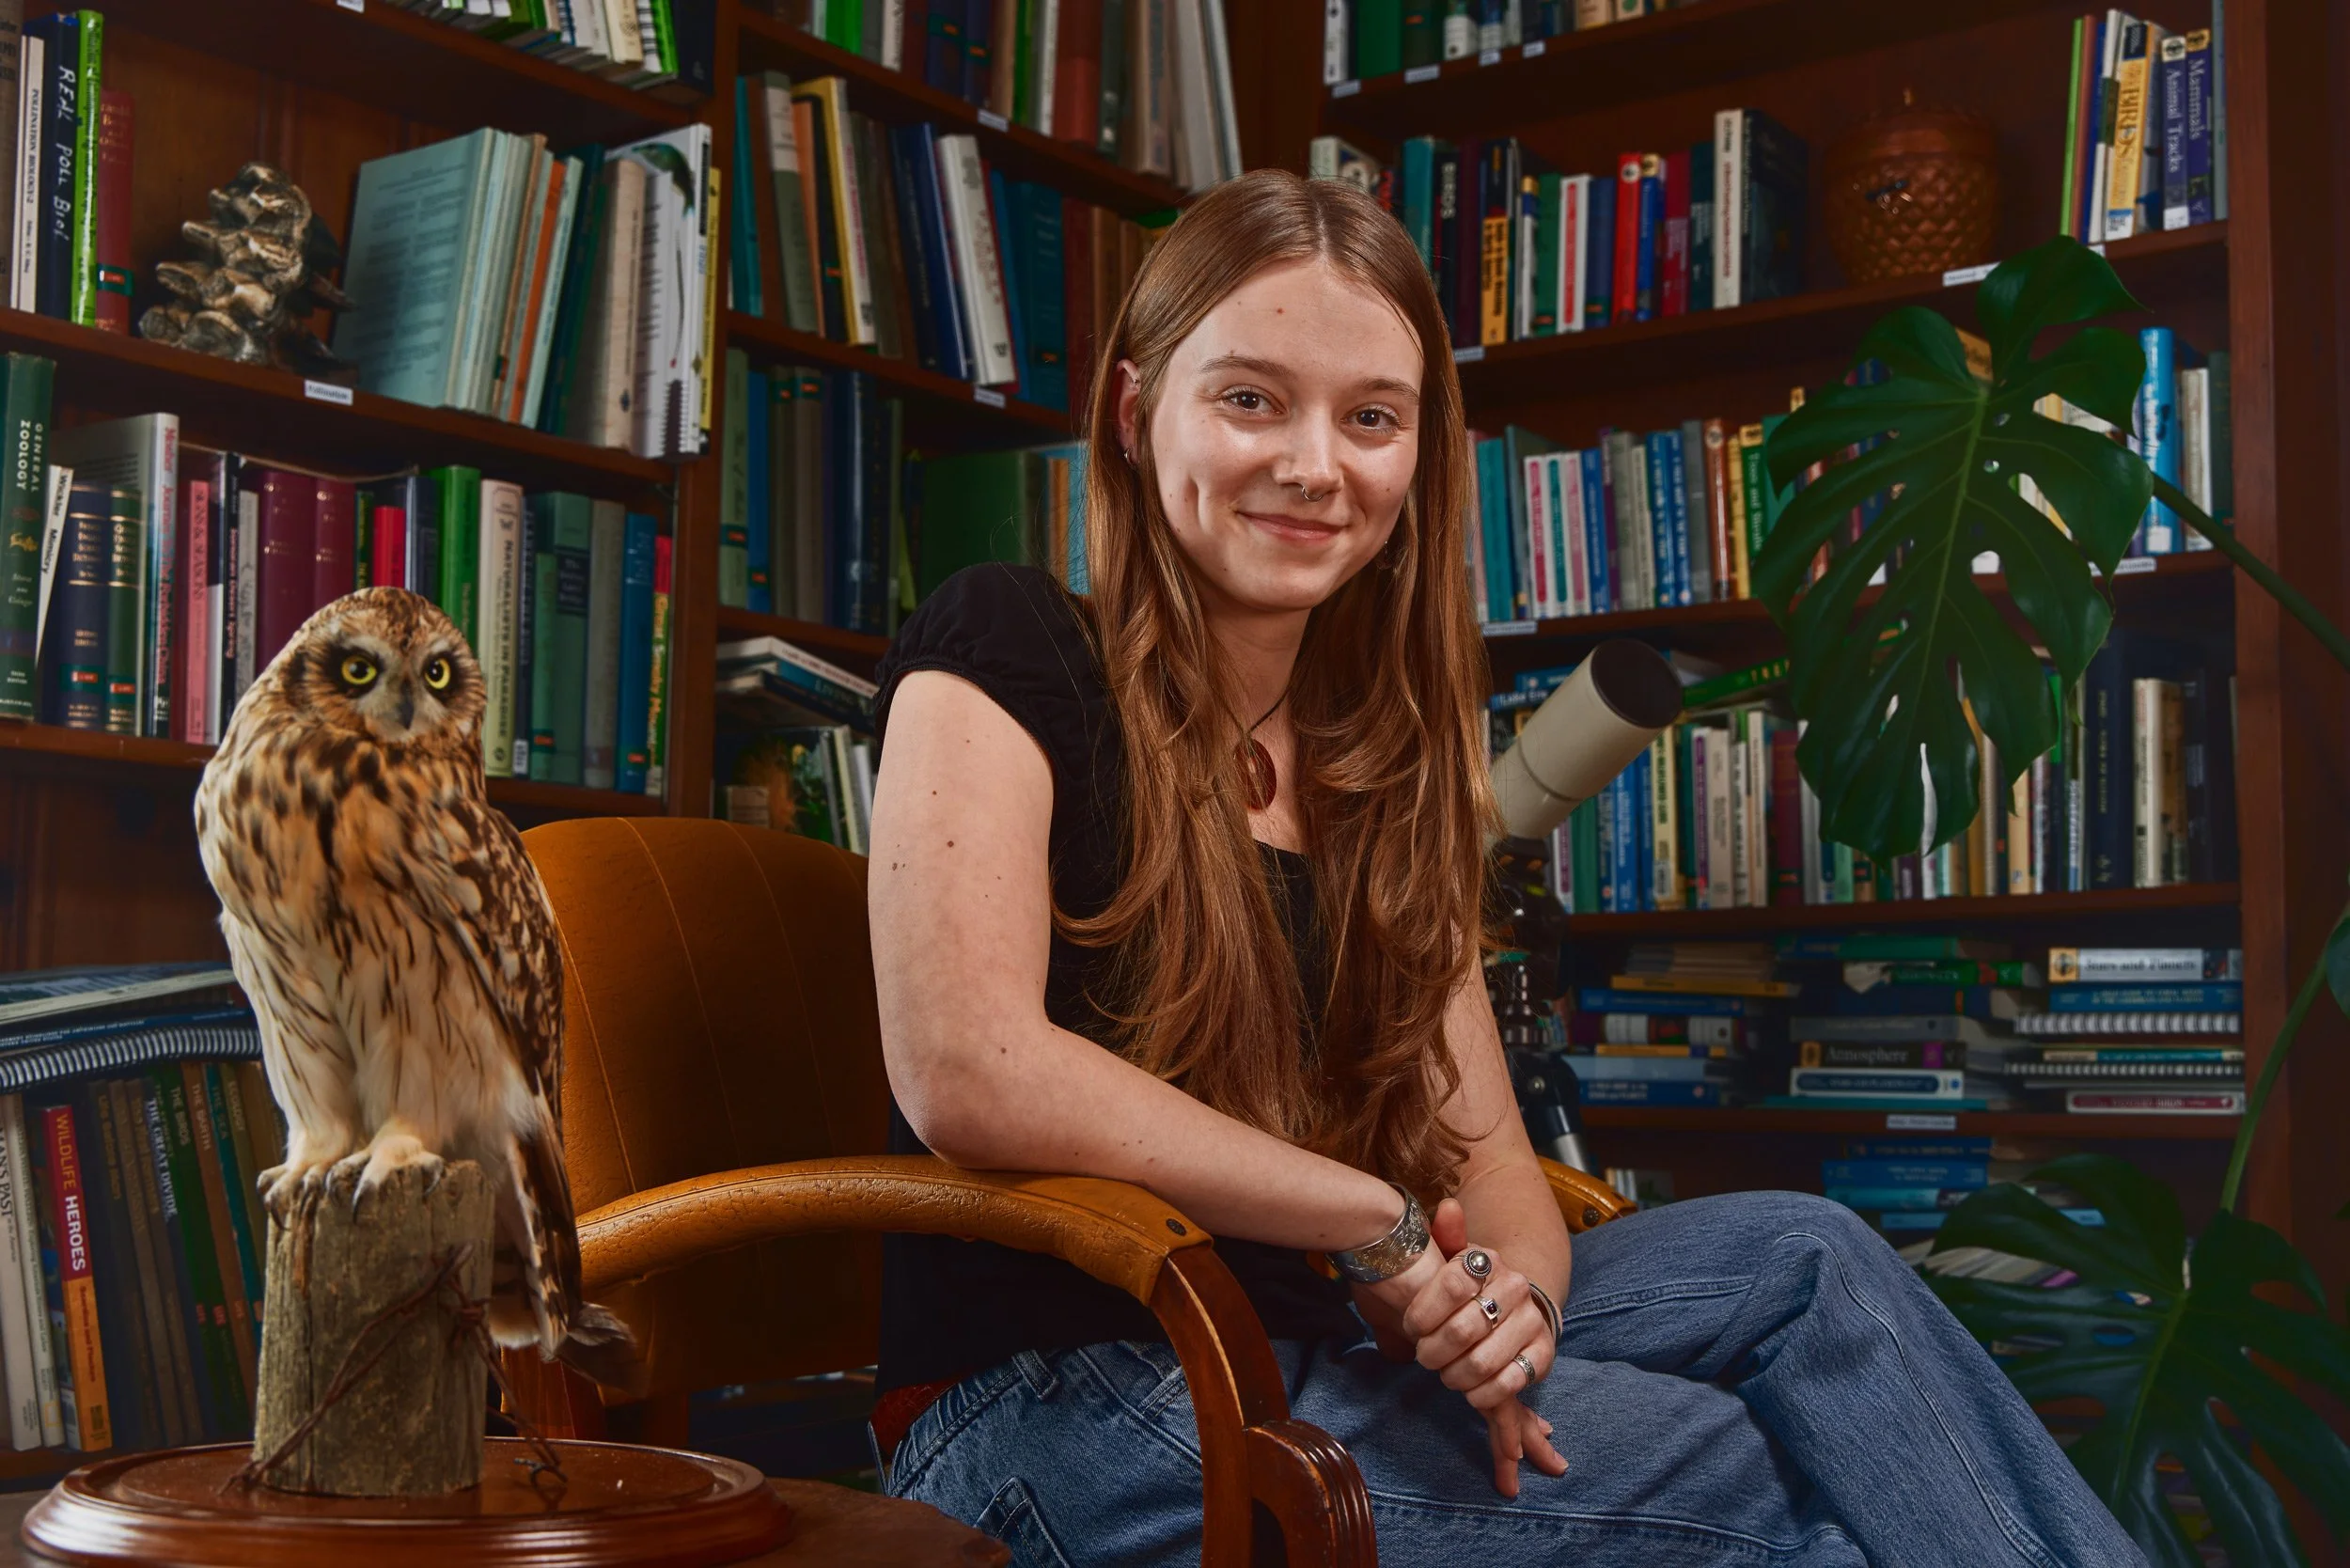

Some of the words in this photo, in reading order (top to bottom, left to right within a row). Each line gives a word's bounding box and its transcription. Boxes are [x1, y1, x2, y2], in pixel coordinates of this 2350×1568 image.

[2167, 70, 2183, 120] Animal
[2188, 58, 2206, 140] Mammals
[2168, 124, 2184, 174] Tracks
[16, 420, 31, 492] ZOOLOGY
[31, 422, 43, 494] GENERAL
[58, 474, 70, 517] Wickler
[42, 529, 58, 575] Mimicry
[501, 540, 514, 641] NATURALISTS
[653, 594, 668, 639] Great
[650, 644, 665, 695] Smoky
[498, 665, 510, 738] PARADISE
[1826, 1041, 1907, 1065] Atmosphere
[146, 1097, 158, 1121] THE
[170, 1086, 184, 1108] THE
[56, 1113, 77, 1191] WILDLIFE
[151, 1127, 169, 1168] GREAT
[1, 1183, 13, 1216] PAST
[161, 1171, 179, 1217] DIVIDE
[65, 1195, 86, 1271] HEROES
